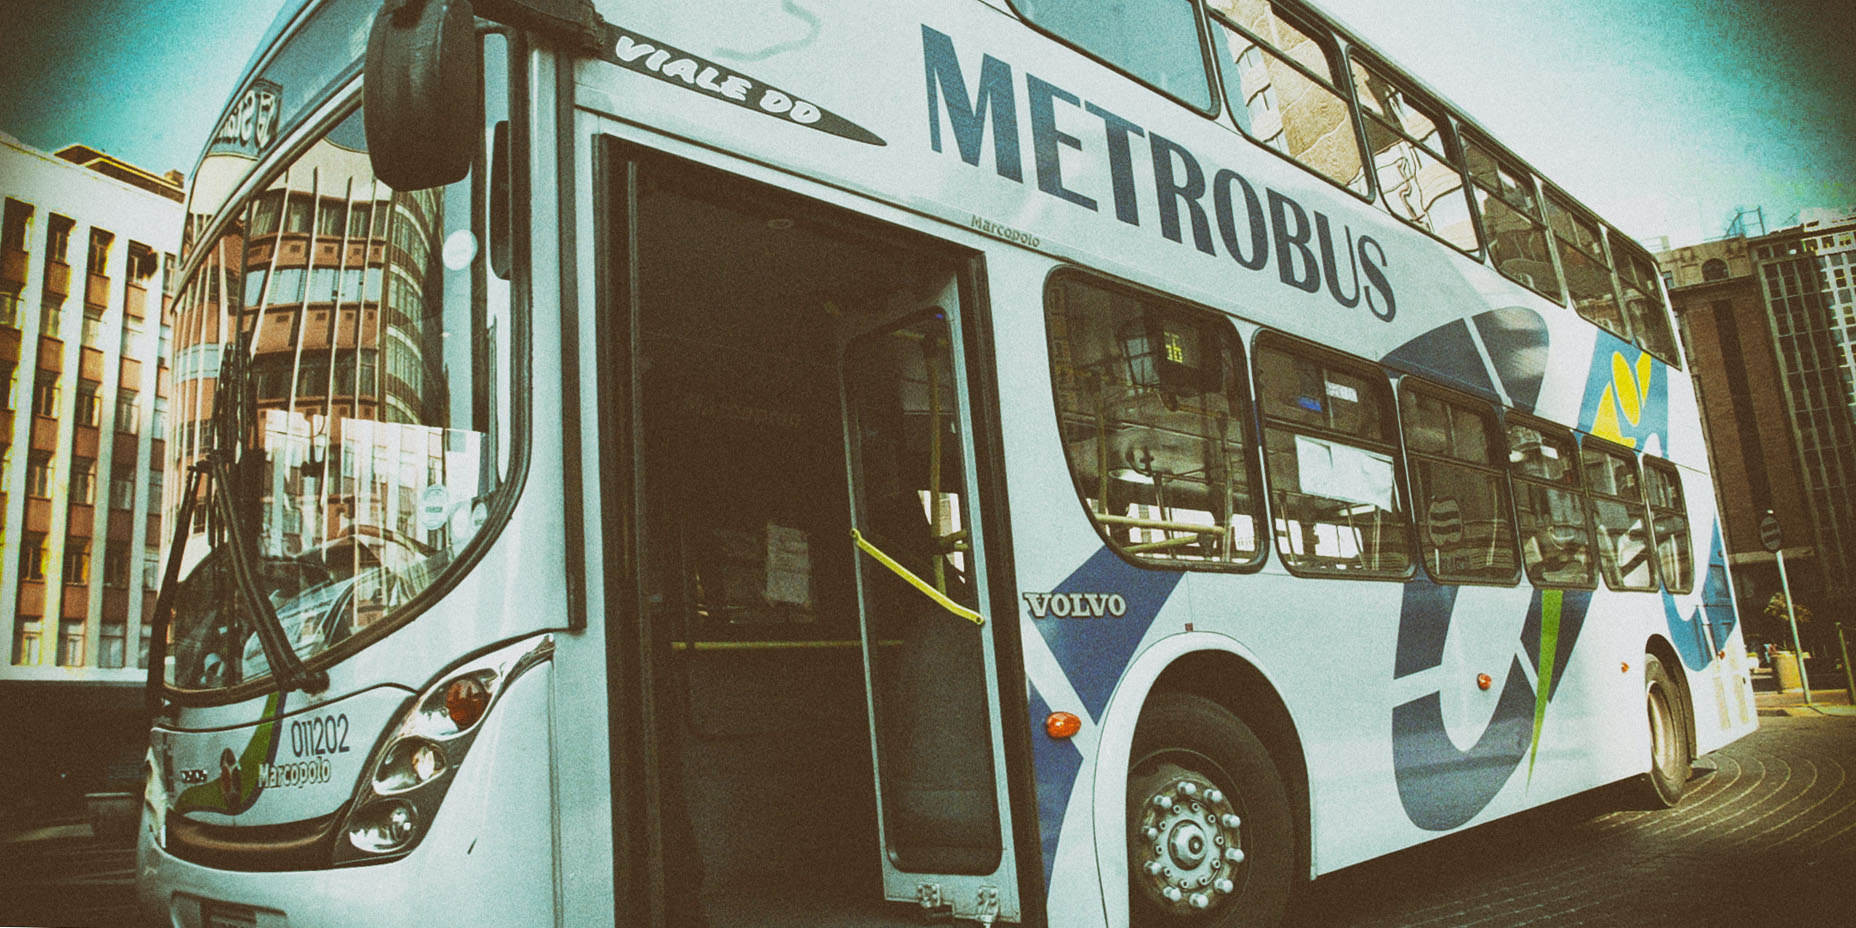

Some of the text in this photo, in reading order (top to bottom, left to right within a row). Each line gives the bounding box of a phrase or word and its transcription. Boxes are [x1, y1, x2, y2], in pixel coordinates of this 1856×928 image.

[615, 35, 822, 123] VIALE DD
[920, 23, 1397, 323] METROBUS
[971, 214, 1040, 247] Marcopolo
[1022, 592, 1127, 618] VOLVO
[291, 713, 350, 757] 011202
[258, 756, 332, 788] Marcopolo
